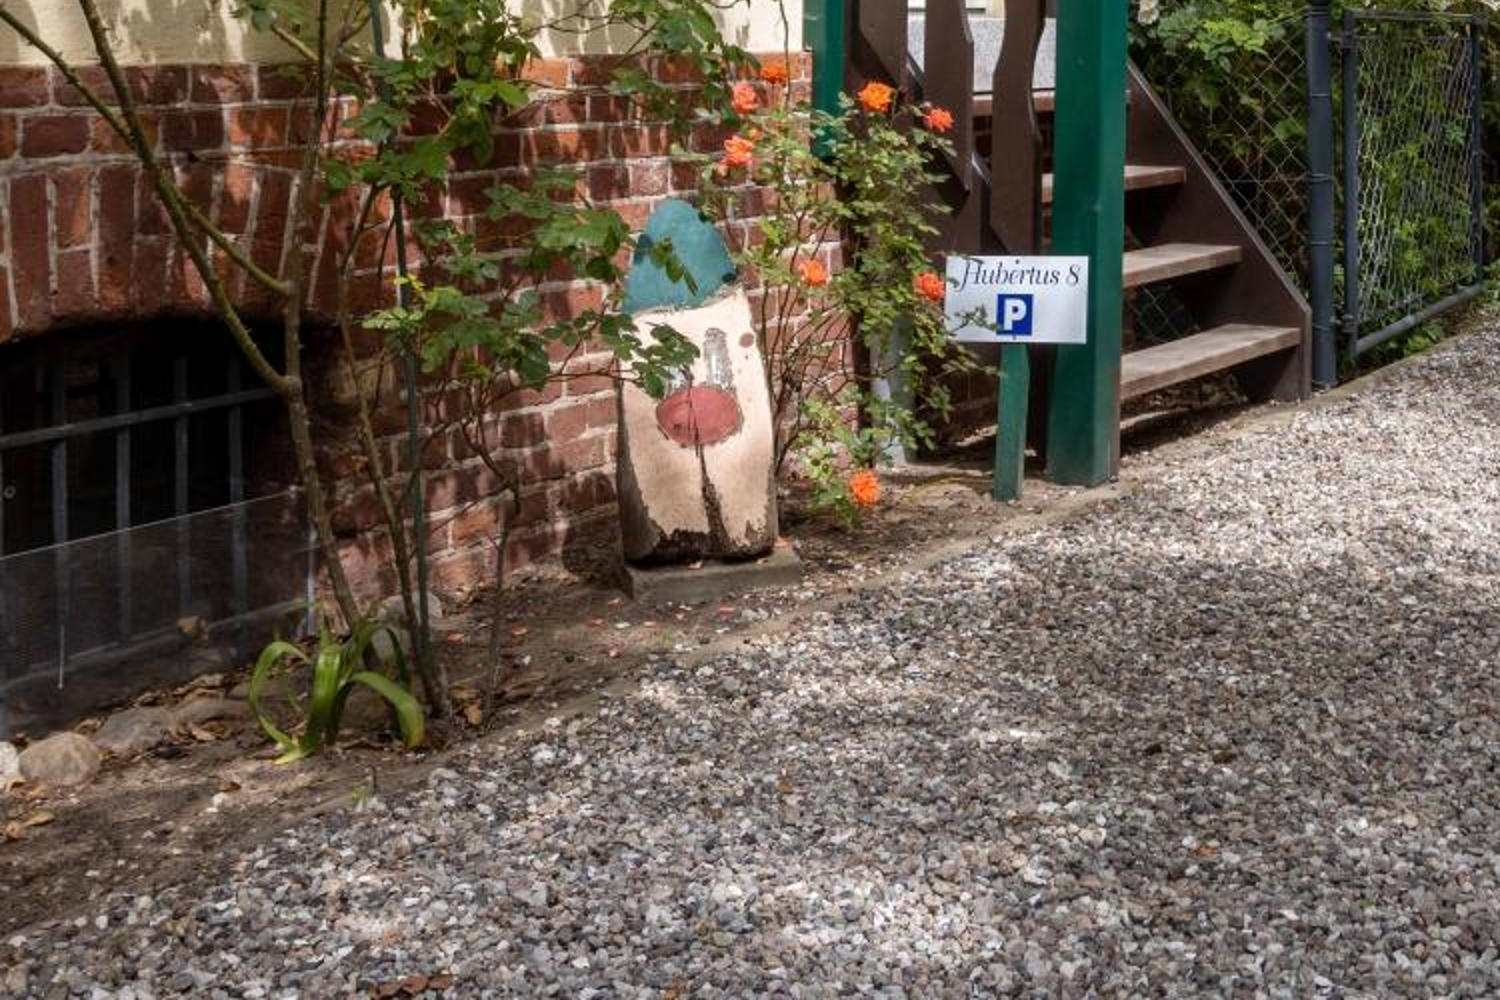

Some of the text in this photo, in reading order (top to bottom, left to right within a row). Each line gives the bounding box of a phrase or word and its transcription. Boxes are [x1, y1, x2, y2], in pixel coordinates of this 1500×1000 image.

[956, 257, 1081, 291] Hubertus 8
[1003, 298, 1027, 331] P
